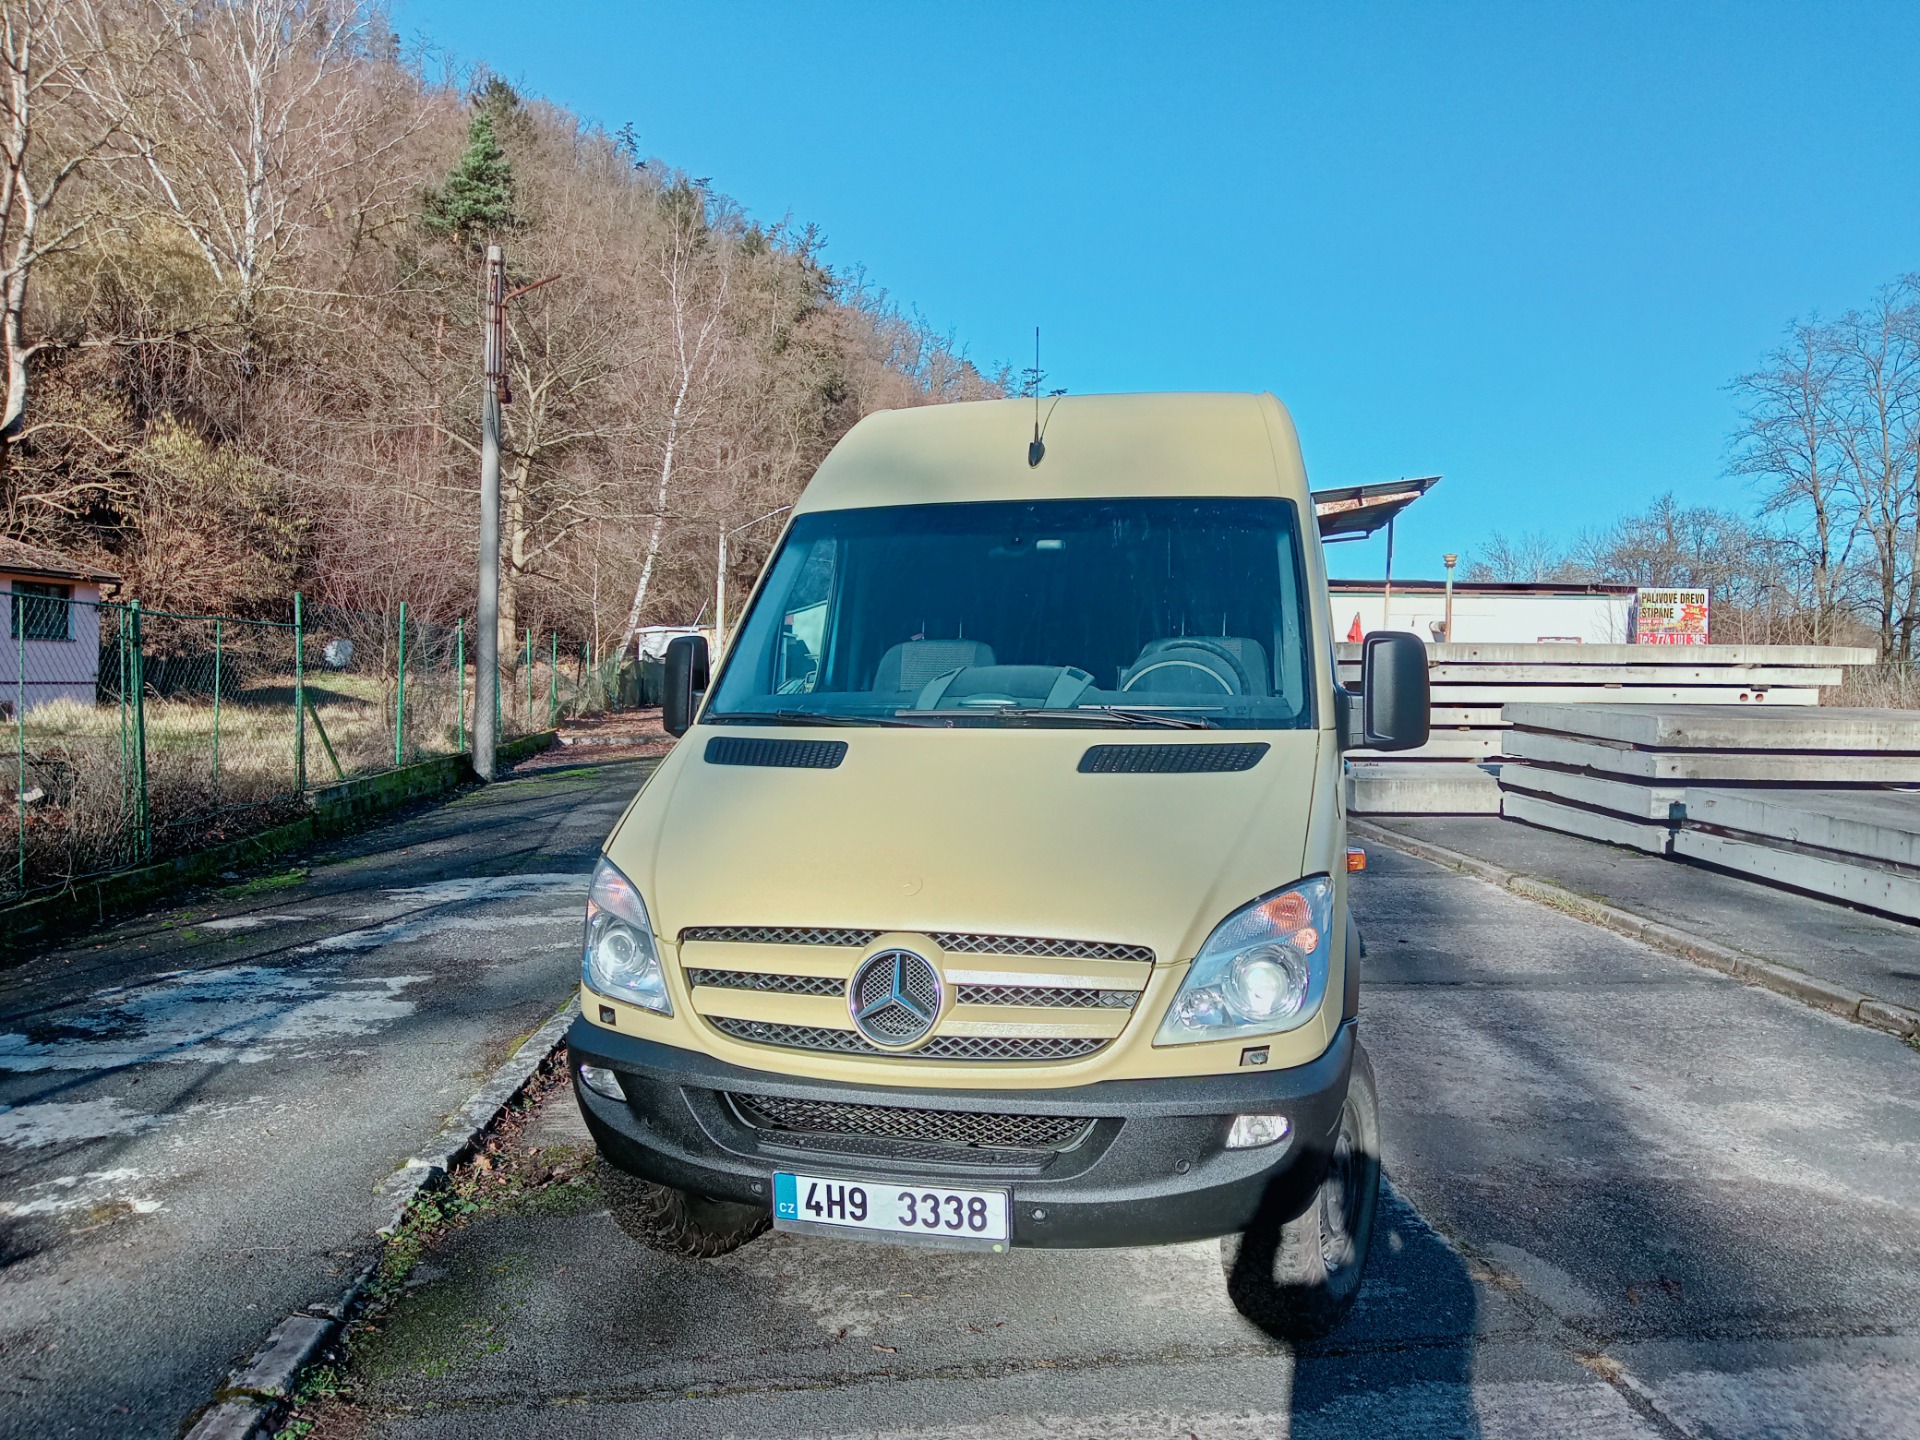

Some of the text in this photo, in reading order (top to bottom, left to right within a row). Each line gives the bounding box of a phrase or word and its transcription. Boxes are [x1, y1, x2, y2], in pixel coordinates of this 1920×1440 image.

[779, 1202, 795, 1214] CZ
[805, 1183, 987, 1232] 4H9 3338
